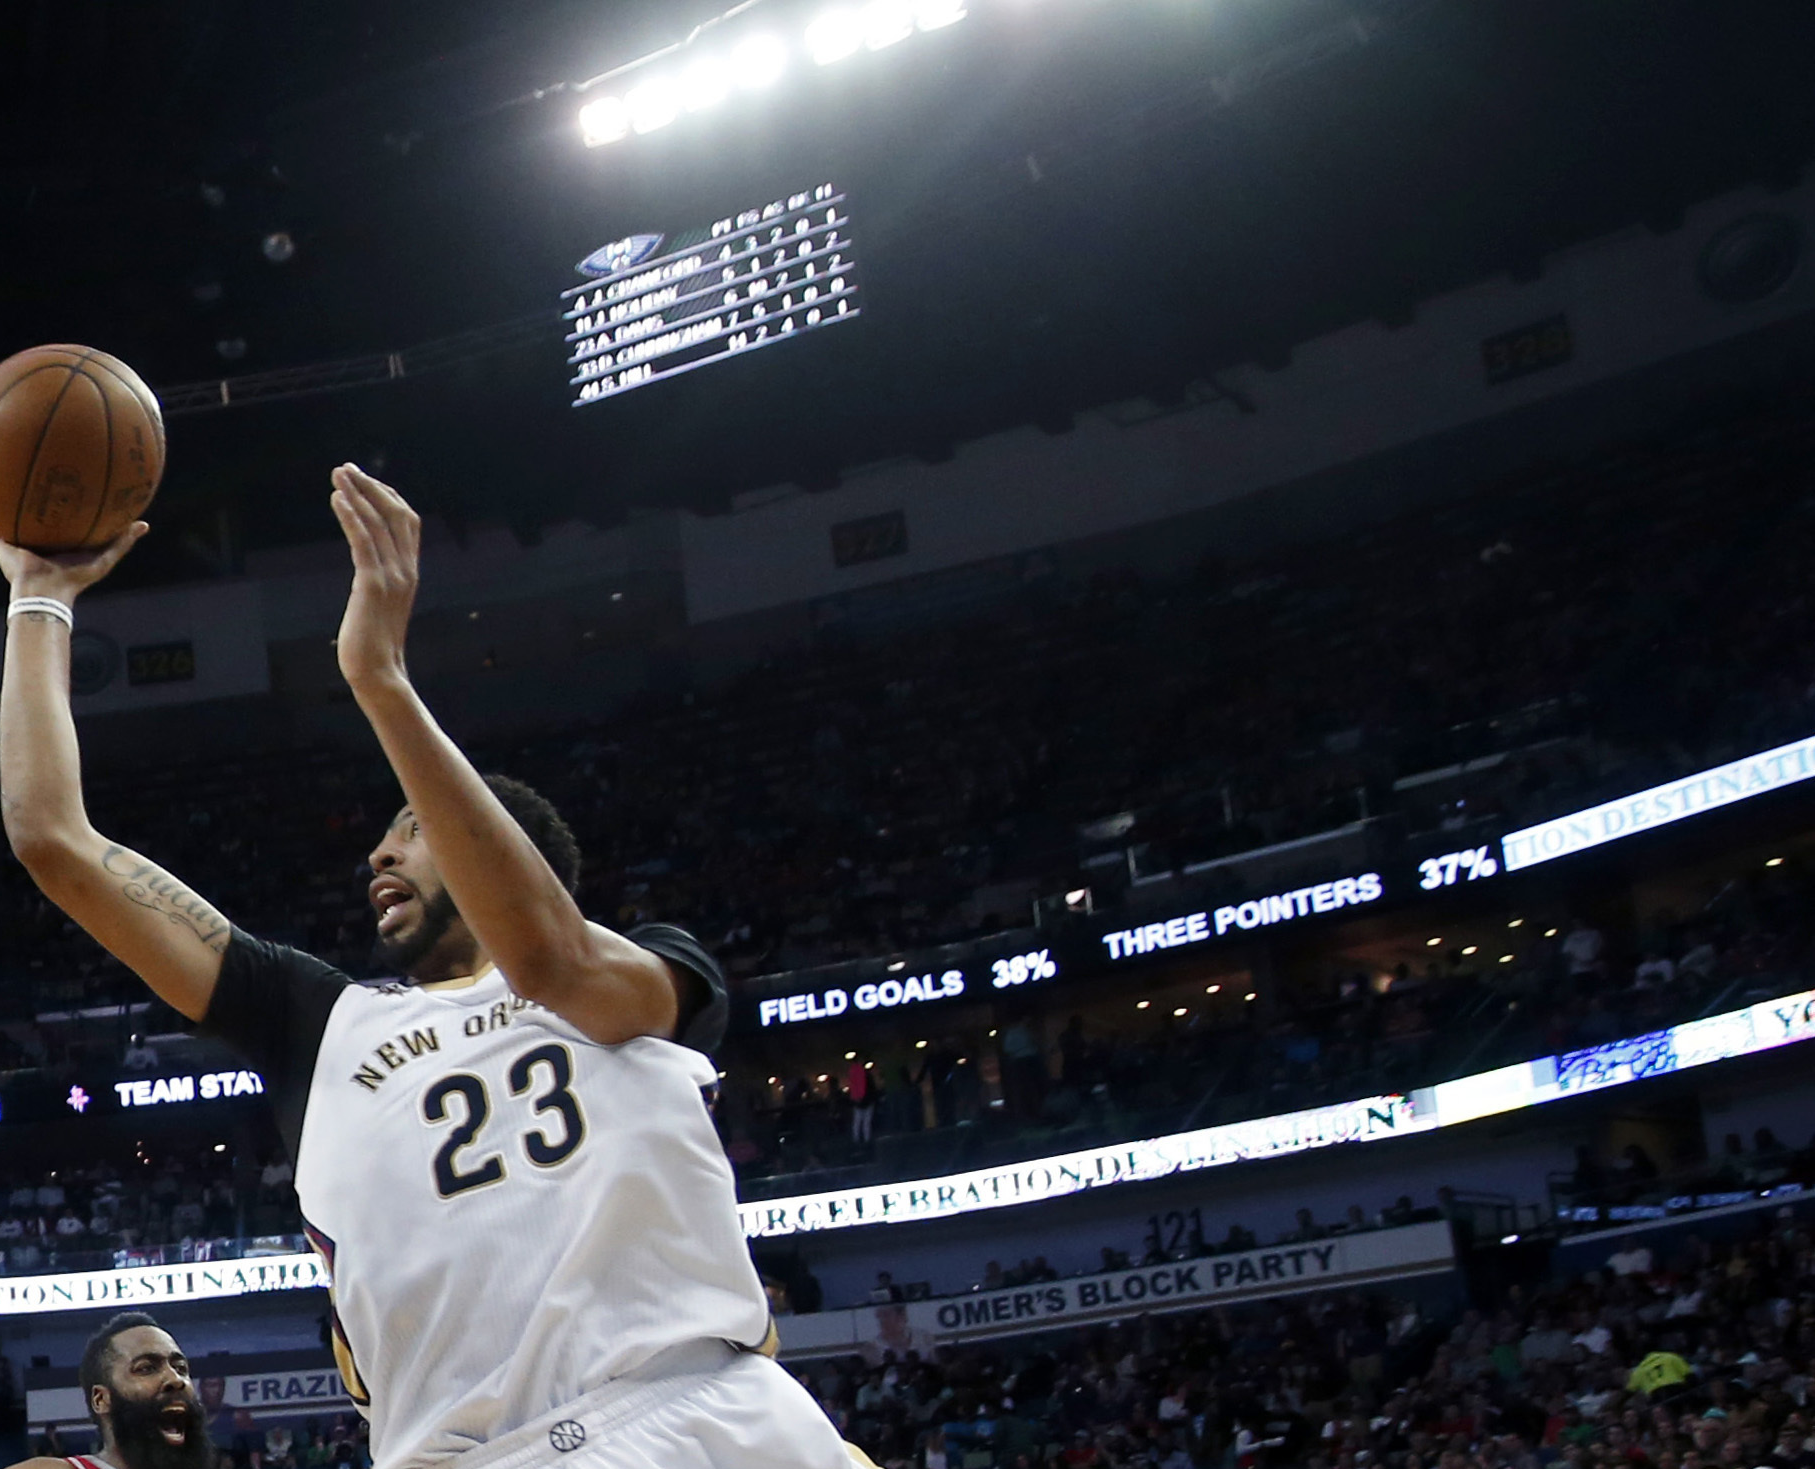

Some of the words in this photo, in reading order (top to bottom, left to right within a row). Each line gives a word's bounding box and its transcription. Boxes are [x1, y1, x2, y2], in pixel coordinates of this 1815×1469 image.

[1102, 912, 1210, 960] THREE
[1214, 872, 1383, 936] POINTERS
[1418, 845, 1497, 890] 37%
[759, 988, 848, 1027] FIELD
[853, 970, 965, 1010] GOALS
[991, 948, 1057, 988] 38%
[114, 1075, 195, 1107] TEAM
[350, 1025, 440, 1091] NEW
[422, 1040, 588, 1199] 23
[85, 1261, 323, 1303] DESTINATIO
[938, 1286, 1066, 1329] OMER'S
[1078, 1266, 1200, 1309] BLOCK
[1213, 1245, 1337, 1288] PARTY
[241, 1375, 346, 1403] FRAZI
